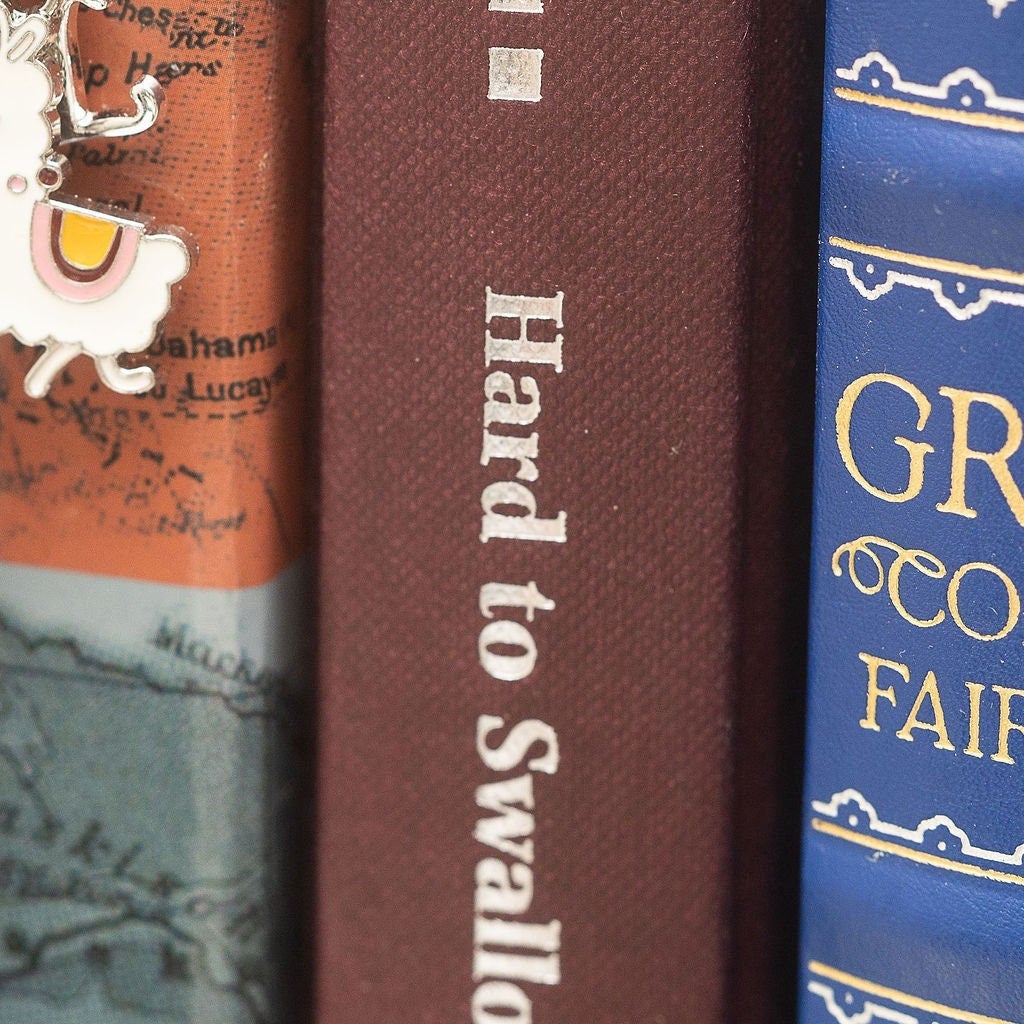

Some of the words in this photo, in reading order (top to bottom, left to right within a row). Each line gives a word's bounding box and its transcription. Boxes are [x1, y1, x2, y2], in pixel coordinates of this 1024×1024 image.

[479, 285, 567, 544] Hard
[835, 372, 1024, 528] GR
[478, 580, 556, 682] to
[471, 714, 562, 1024] Swallo
